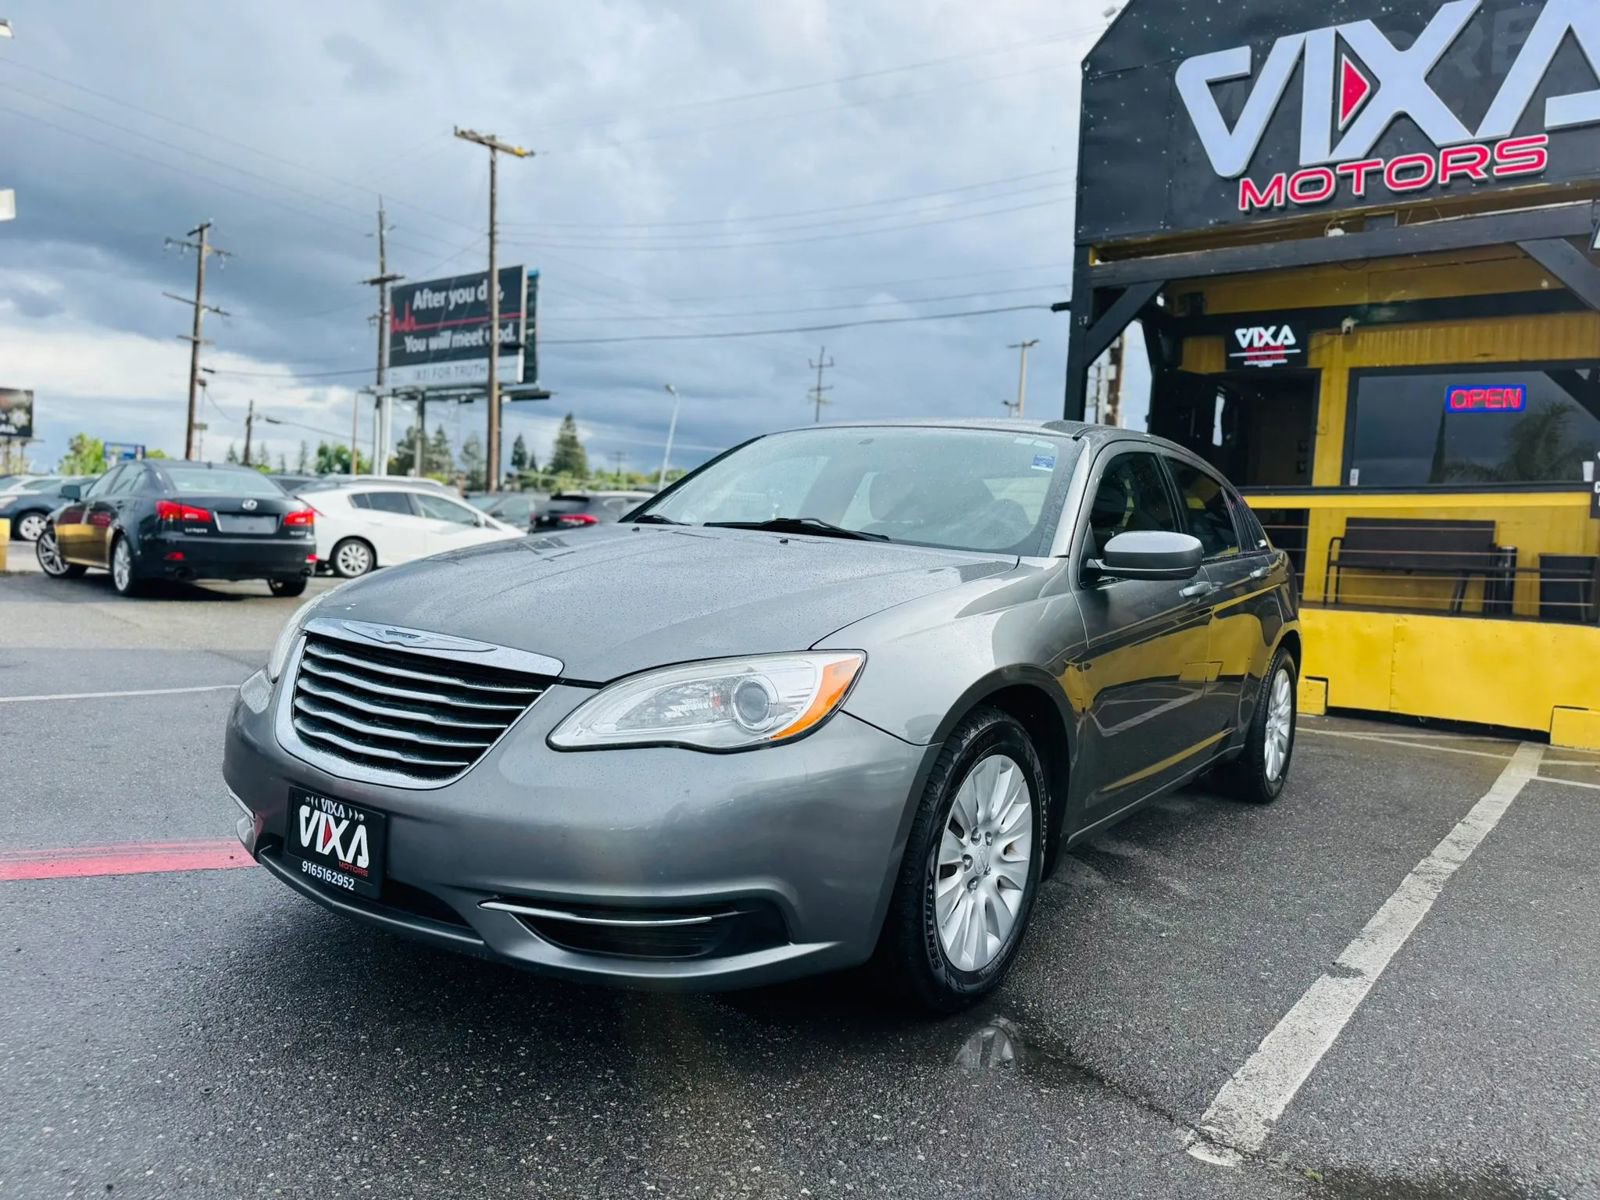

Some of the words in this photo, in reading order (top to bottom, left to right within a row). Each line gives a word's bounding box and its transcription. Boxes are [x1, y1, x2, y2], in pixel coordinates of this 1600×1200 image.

[1175, 0, 1600, 178] VIXA
[1238, 134, 1551, 212] MOTORS
[413, 289, 446, 310] After
[449, 286, 475, 310] you
[405, 336, 426, 352] You
[429, 330, 452, 349] will
[452, 328, 484, 348] meet
[1234, 324, 1297, 349] VIXA
[1450, 388, 1522, 408] OPEN
[322, 799, 345, 818] VIXA
[300, 805, 369, 867] VIXA
[302, 862, 354, 890] 9165162952
